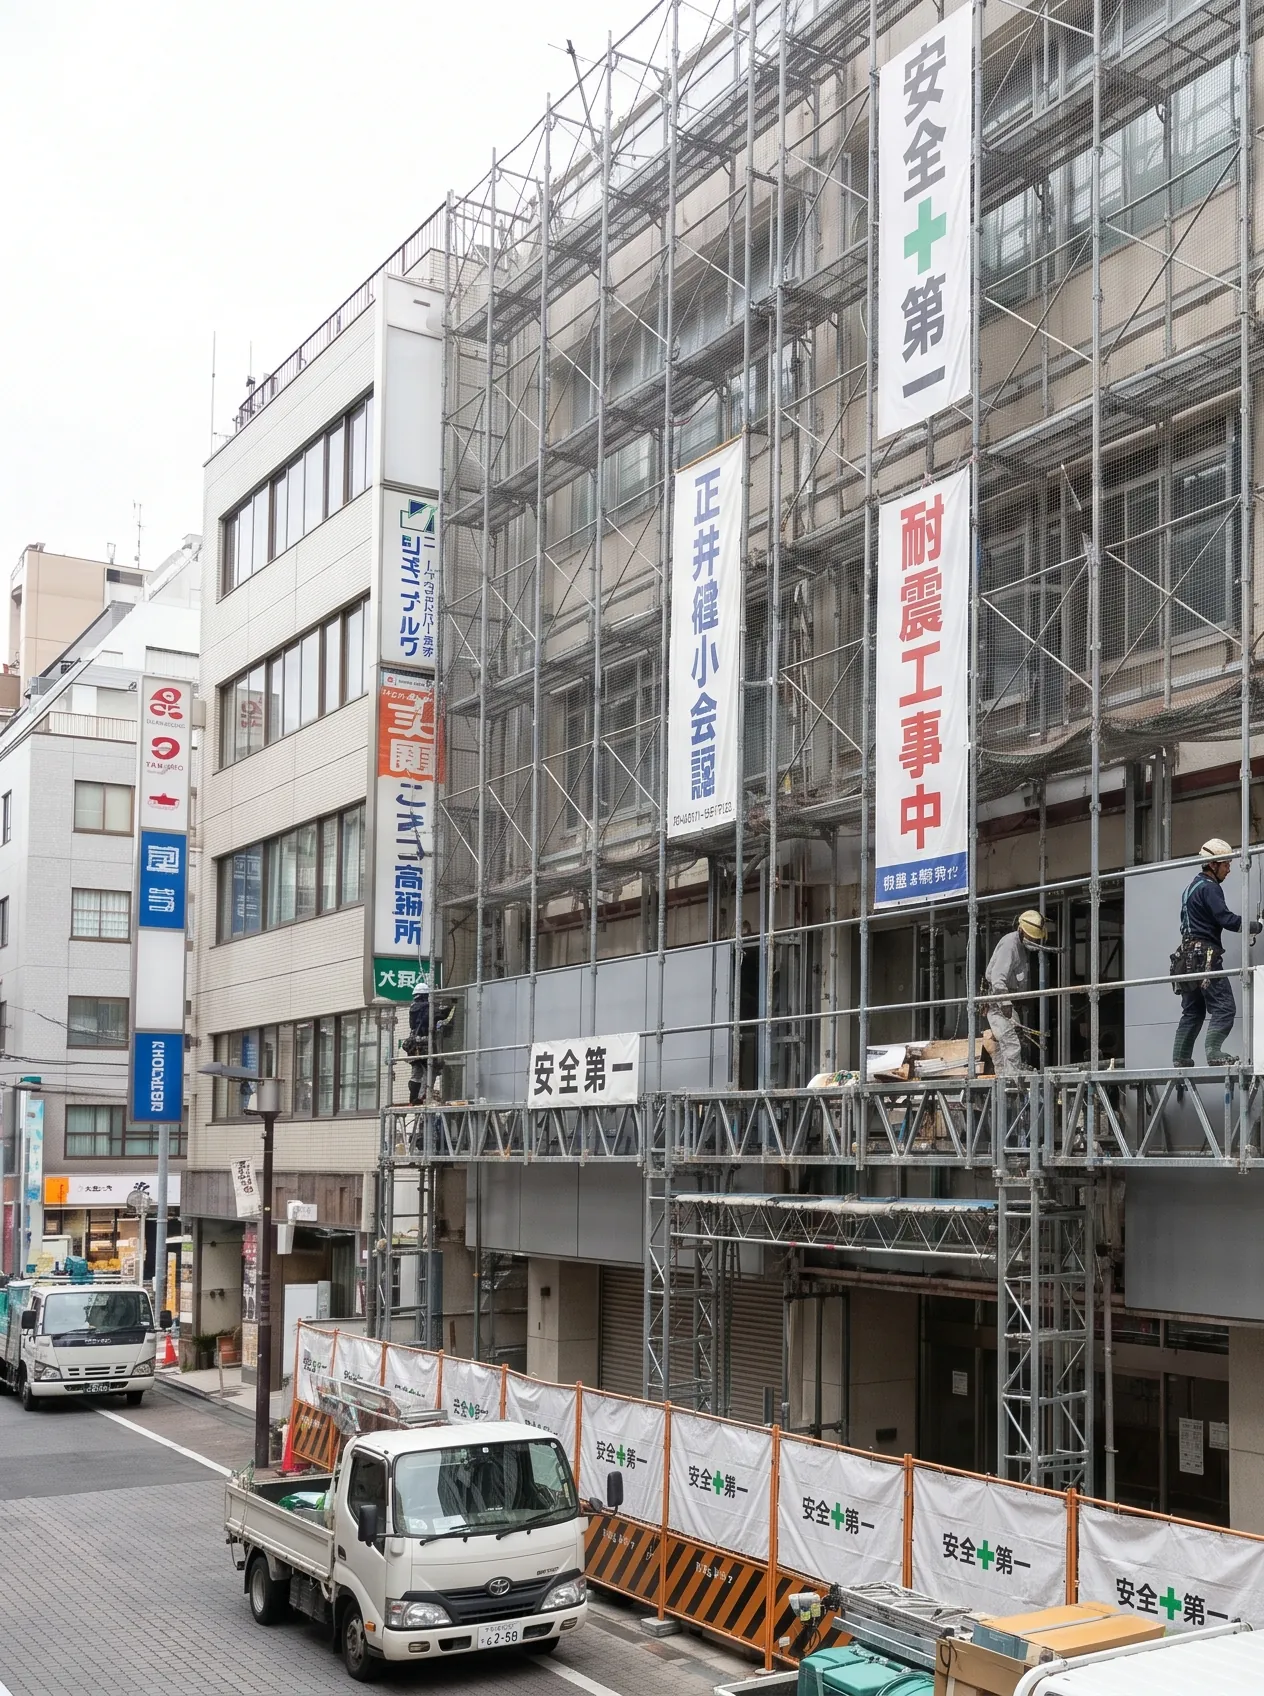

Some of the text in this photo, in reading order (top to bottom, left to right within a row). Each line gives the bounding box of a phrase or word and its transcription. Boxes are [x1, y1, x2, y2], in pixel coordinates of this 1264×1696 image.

[899, 494, 944, 849] 耐震工事中
[534, 1046, 633, 1096] 安全第一
